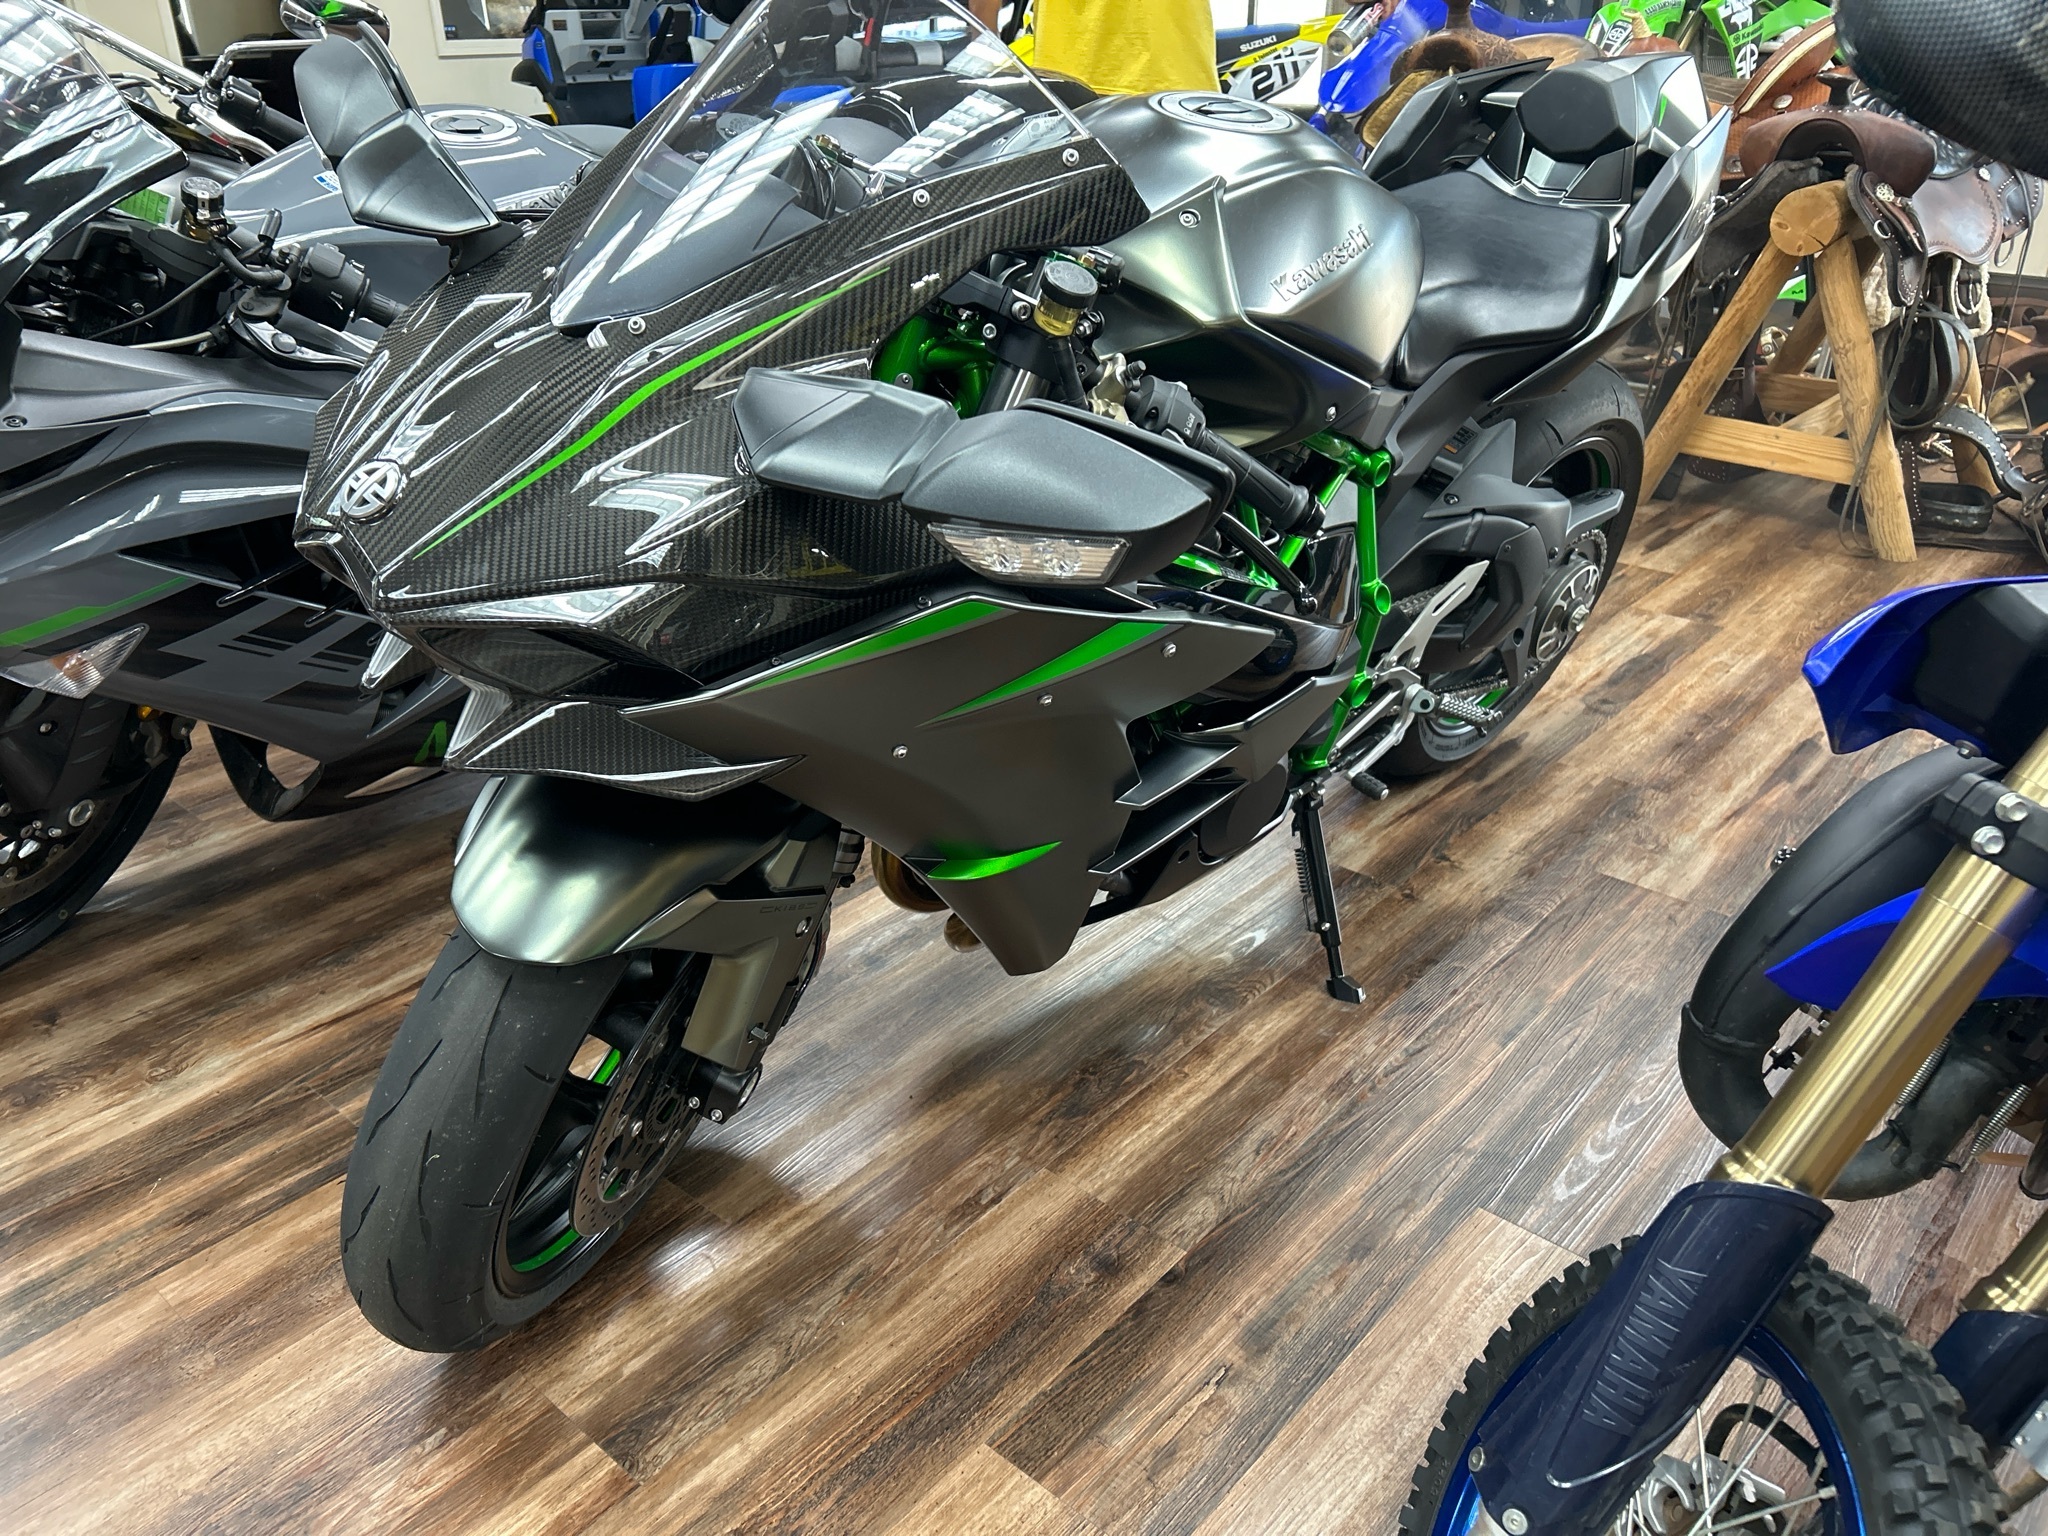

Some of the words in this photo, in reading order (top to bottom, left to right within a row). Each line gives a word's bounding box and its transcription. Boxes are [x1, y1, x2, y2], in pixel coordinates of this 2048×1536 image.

[1240, 35, 1278, 52] SUZUKI
[1251, 61, 1301, 100] 211
[1270, 223, 1374, 302] Kawasaki
[1582, 1257, 1708, 1437] YAMAHA
